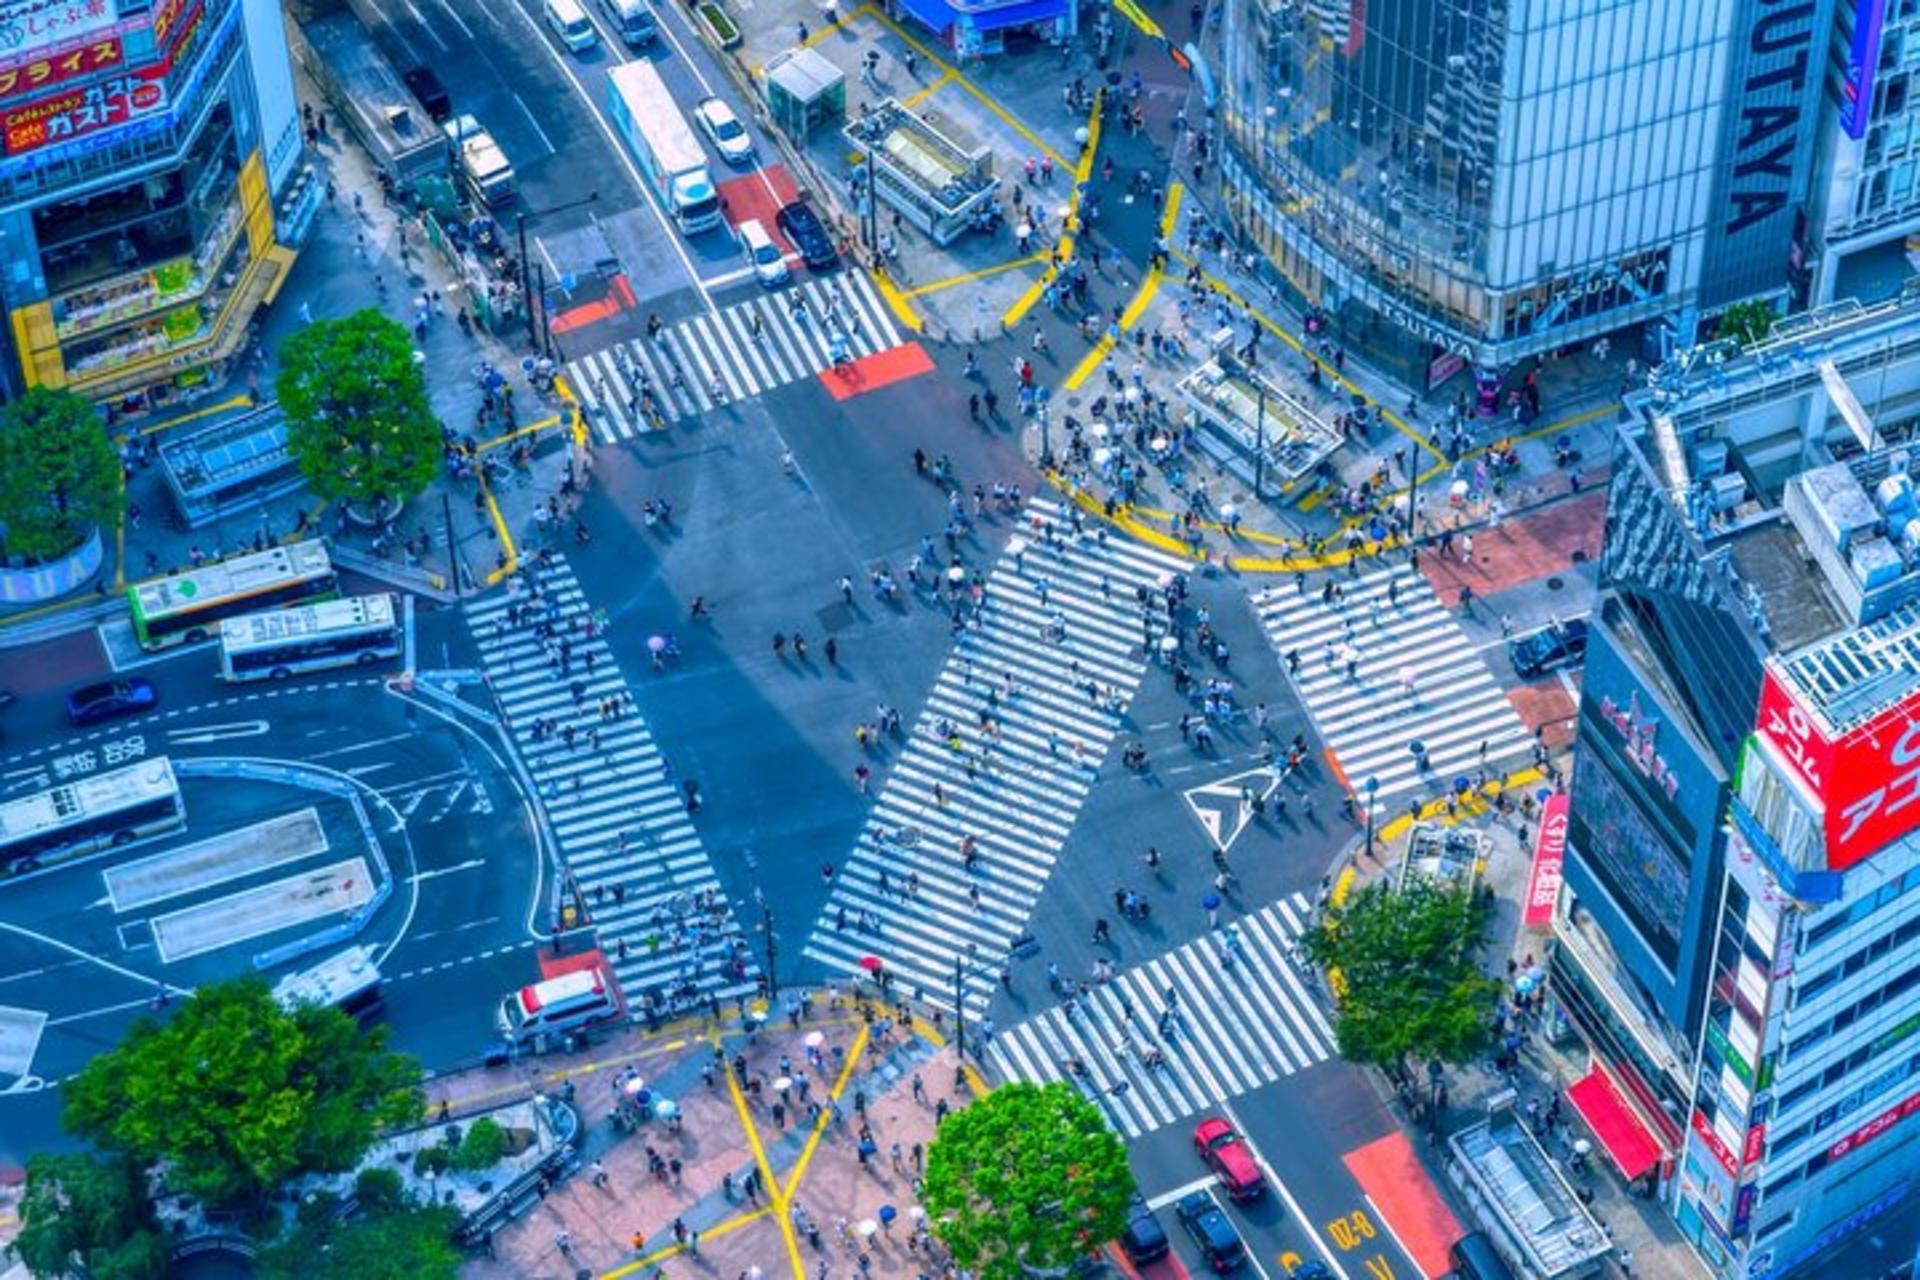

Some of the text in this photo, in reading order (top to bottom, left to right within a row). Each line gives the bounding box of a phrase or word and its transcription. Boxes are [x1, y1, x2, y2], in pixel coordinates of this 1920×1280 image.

[48, 102, 120, 139] ガスト
[1727, 0, 1816, 235] UTAYA
[1554, 259, 1668, 304] TSUTAYA
[1383, 302, 1474, 361] TSUTAYA
